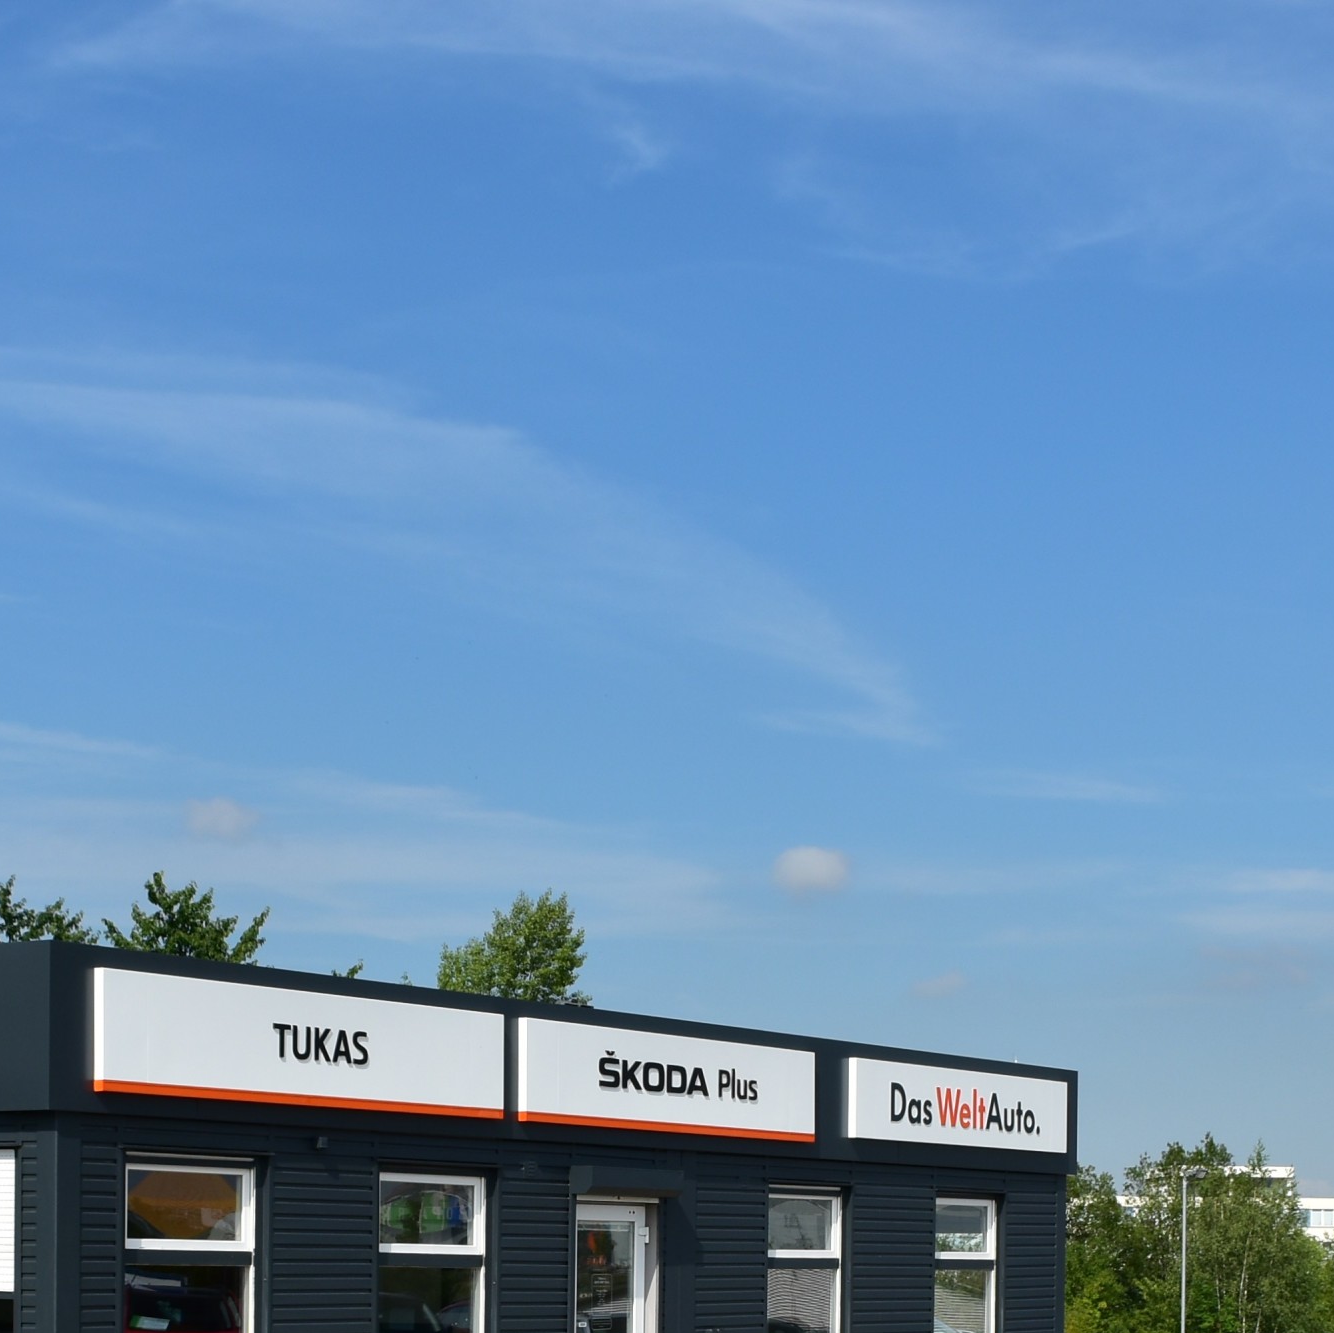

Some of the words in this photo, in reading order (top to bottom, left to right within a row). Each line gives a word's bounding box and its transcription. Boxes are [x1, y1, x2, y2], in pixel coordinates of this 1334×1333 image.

[272, 1022, 370, 1066] TUKAS
[598, 1049, 709, 1099] ŠKODA
[718, 1068, 759, 1101] Plus
[890, 1081, 933, 1125] Das
[936, 1086, 1041, 1135] WeltAuto.
